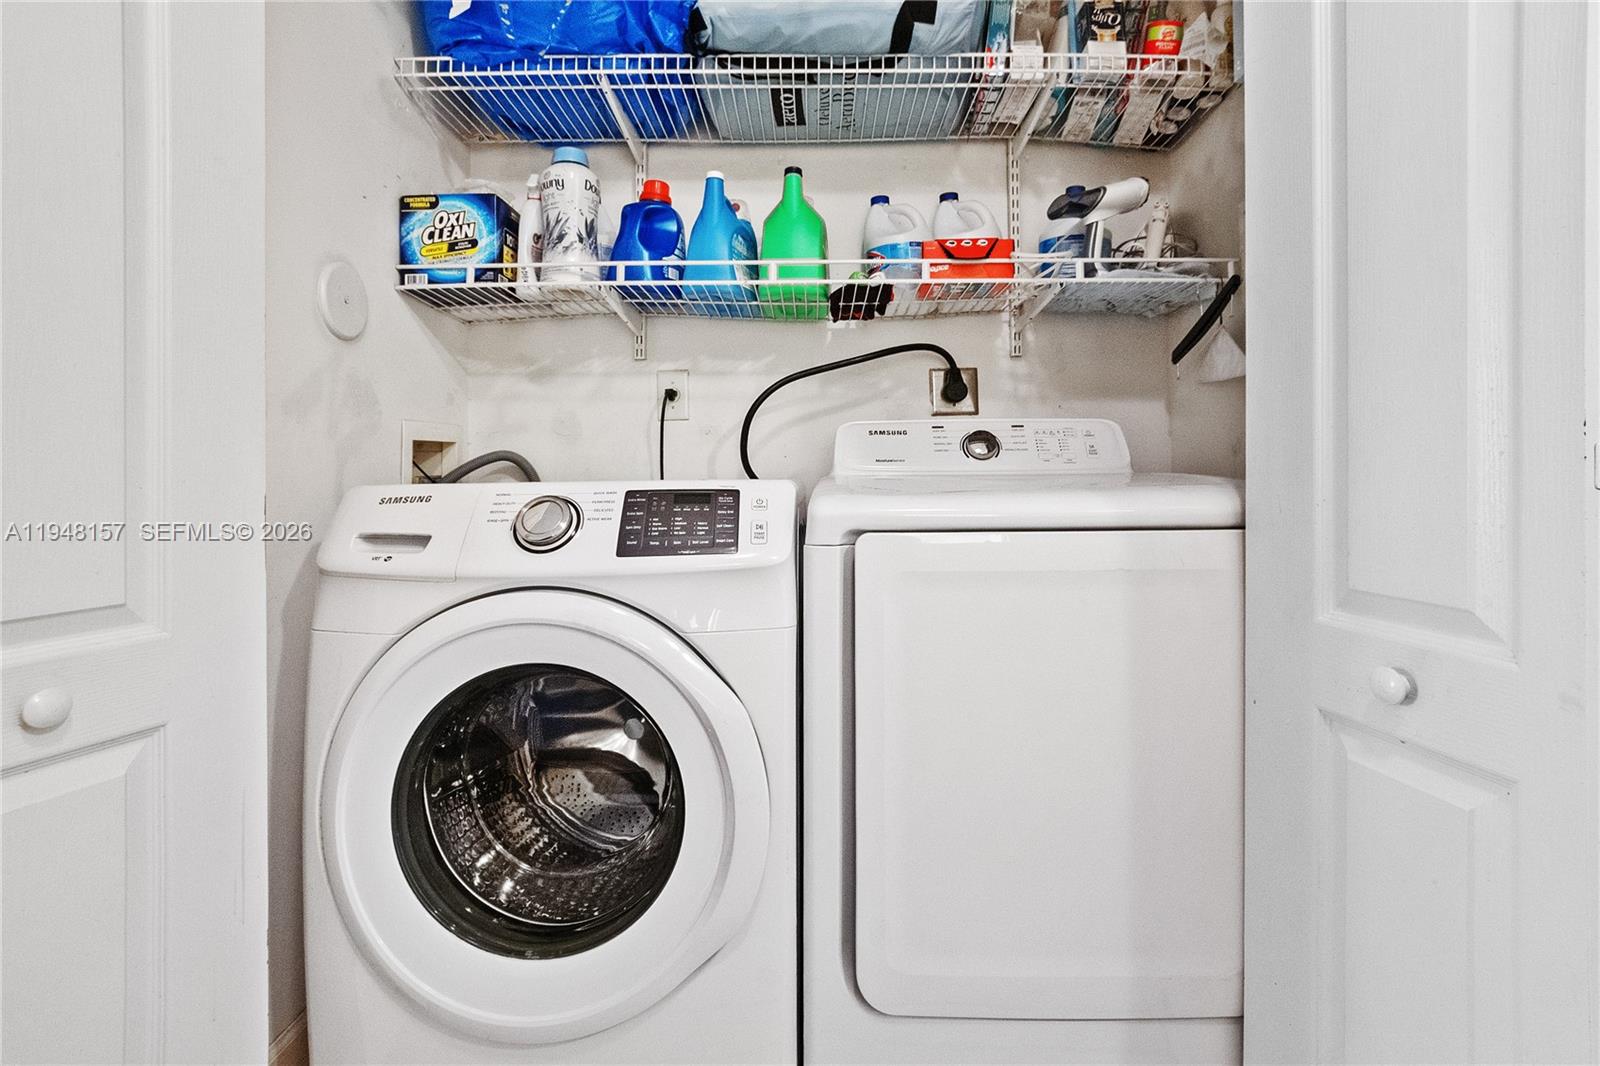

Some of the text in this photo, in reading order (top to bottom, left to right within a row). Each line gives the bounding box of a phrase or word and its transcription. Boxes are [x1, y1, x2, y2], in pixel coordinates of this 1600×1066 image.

[434, 210, 466, 229] OXI
[422, 222, 476, 245] CLEAN
[378, 495, 432, 505] SAMSUNG
